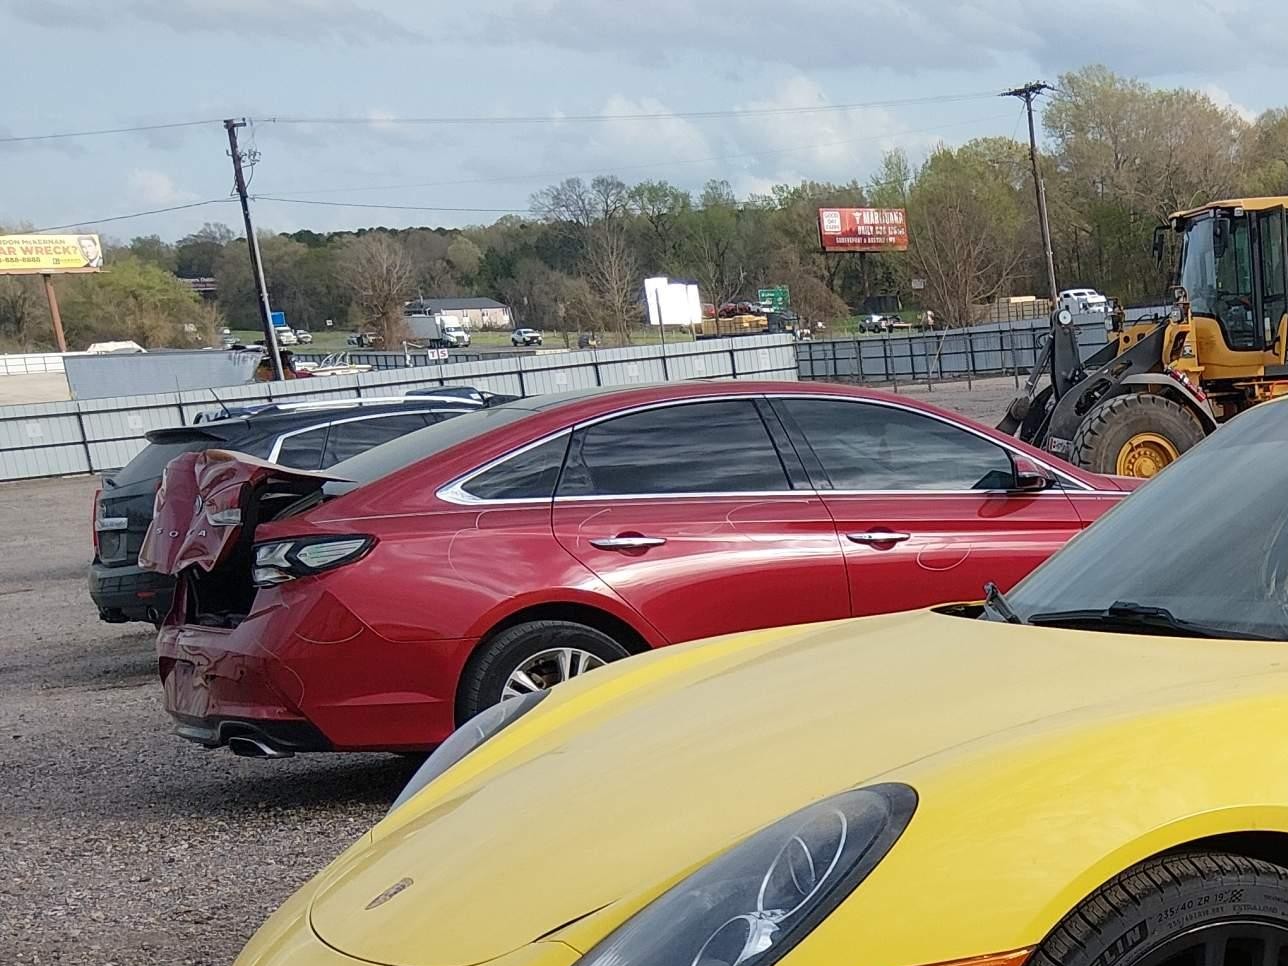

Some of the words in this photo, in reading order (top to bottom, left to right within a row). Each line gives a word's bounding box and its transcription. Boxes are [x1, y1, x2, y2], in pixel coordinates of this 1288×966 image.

[20, 245, 78, 256] WRECK?
[1157, 899, 1194, 923] 235/40
[1197, 895, 1210, 906] ZR
